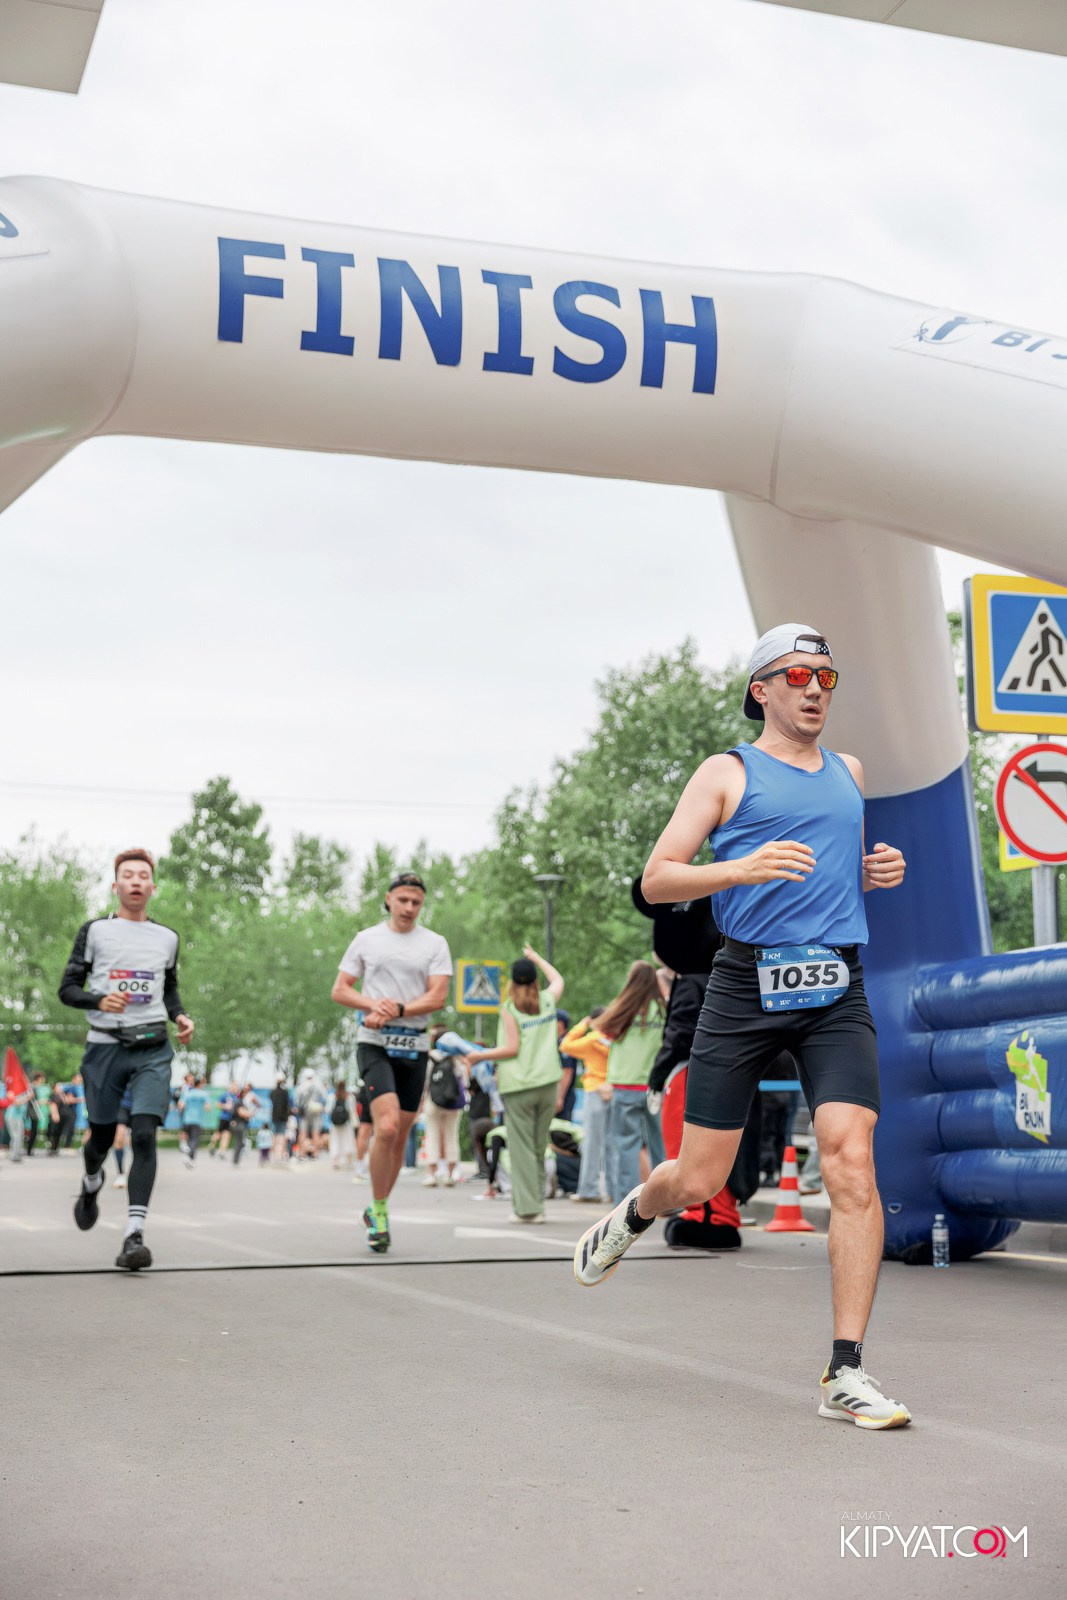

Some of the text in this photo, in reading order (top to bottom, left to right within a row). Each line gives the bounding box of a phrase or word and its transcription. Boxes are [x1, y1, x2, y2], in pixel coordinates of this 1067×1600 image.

[217, 236, 719, 395] FINISH
[768, 952, 781, 960] KM
[770, 963, 839, 991] 1035
[118, 981, 149, 992] 006
[386, 1035, 416, 1048] 1446
[1023, 1110, 1045, 1129] RUN
